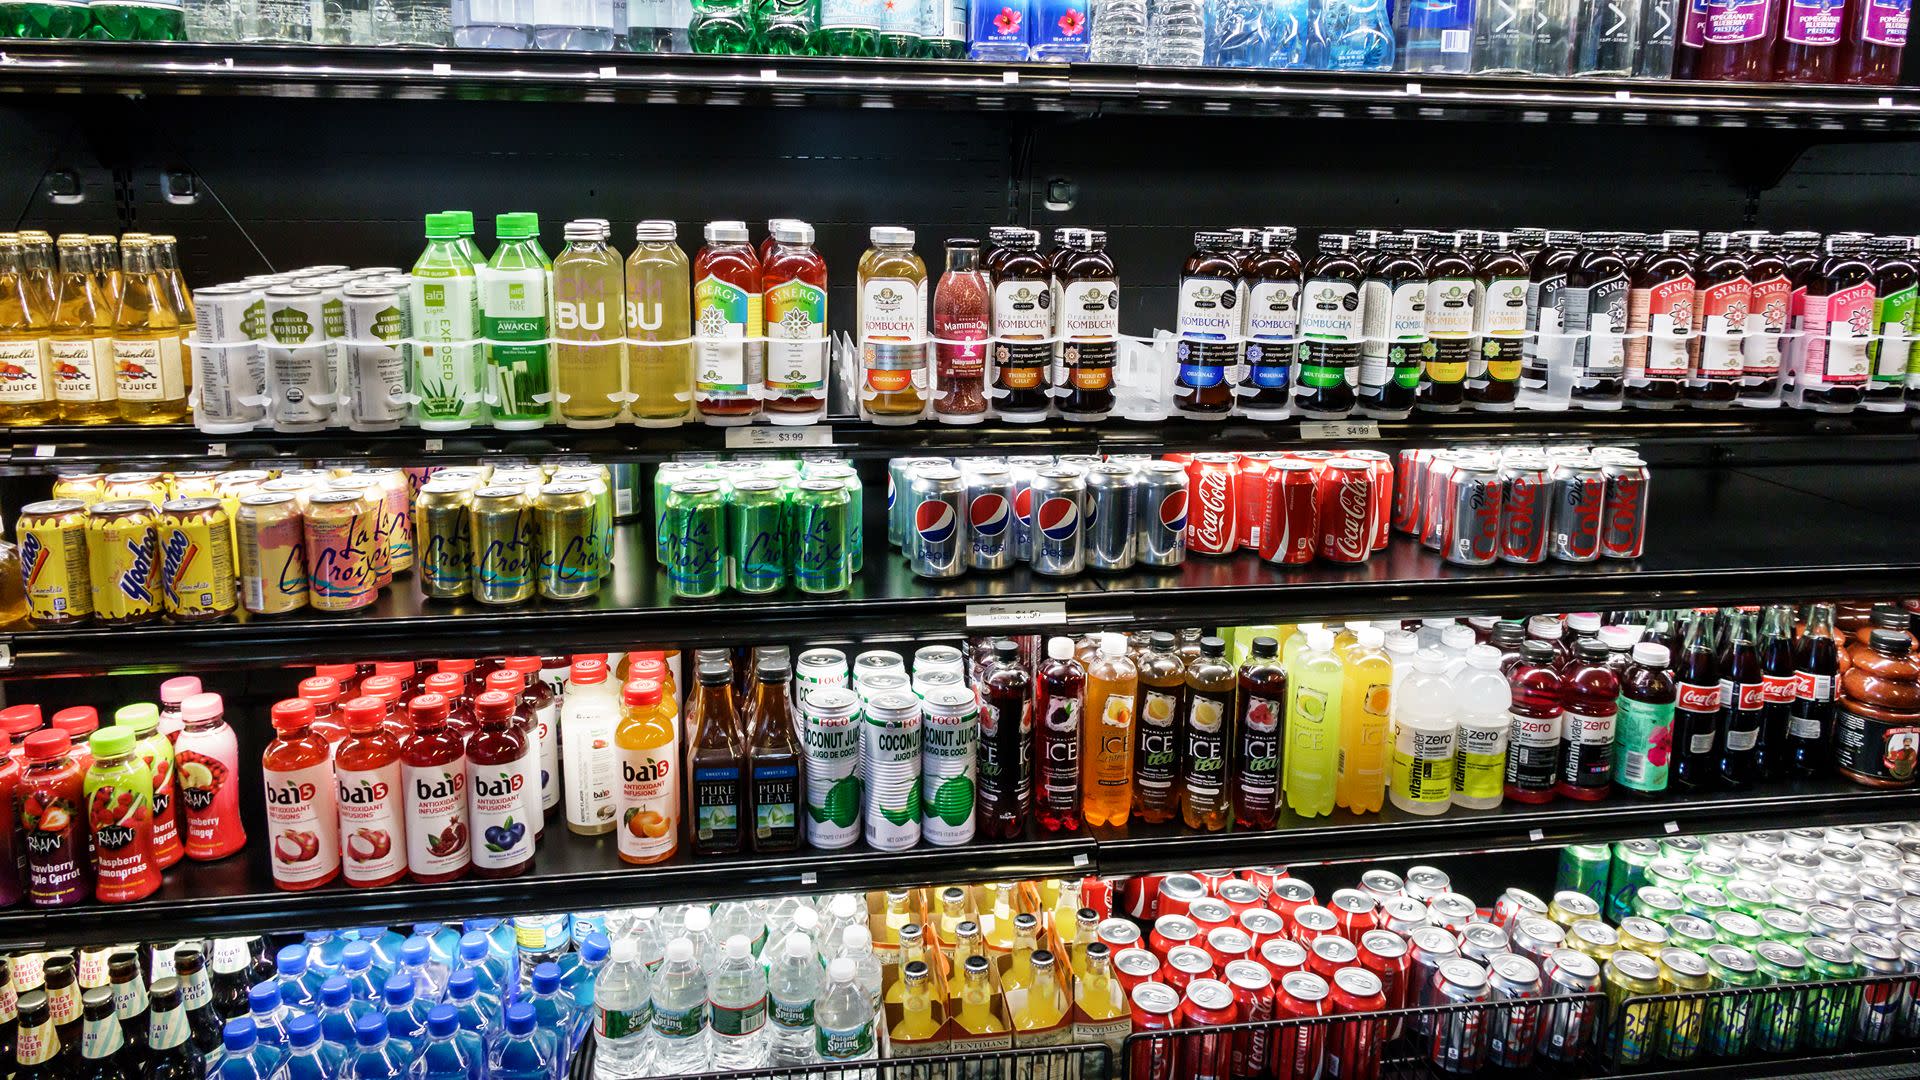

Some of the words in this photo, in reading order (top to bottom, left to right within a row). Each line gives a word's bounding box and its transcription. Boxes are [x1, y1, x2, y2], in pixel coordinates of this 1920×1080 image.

[771, 287, 821, 305] SYNERGY
[497, 322, 537, 331] AWAKEN
[865, 321, 915, 332] KOMBUCHA
[998, 319, 1047, 329] KOMBUCHA
[1067, 319, 1115, 330] KOMBUCHA
[1181, 316, 1231, 328] KOMBUCHA
[1251, 319, 1295, 329] KOMBUCH
[1302, 318, 1352, 329] KOMBUCHA
[273, 325, 308, 334] WONDER
[7, 383, 37, 391] JUICE
[65, 383, 91, 391] JUICE
[1347, 427, 1369, 435] $4.99
[1470, 479, 1485, 510] Diet
[1568, 475, 1583, 506] Diet
[1196, 469, 1228, 550] Coca-Cola
[1602, 474, 1638, 553] Coke
[1336, 474, 1368, 559] Coca-Cola
[1473, 480, 1501, 560] Coke
[1502, 477, 1535, 559] Coke
[1570, 478, 1601, 555] Coke
[680, 506, 710, 548] La
[804, 503, 831, 543] La
[340, 514, 368, 558] La
[313, 546, 379, 592] Croix
[818, 675, 843, 685] FOCO
[820, 717, 848, 727] FOCO
[932, 715, 960, 726] FOCO
[1583, 720, 1610, 731] zero
[1522, 721, 1551, 733] zero
[879, 730, 922, 751] COCONUT
[1190, 732, 1220, 741] SPARKLING
[1294, 729, 1324, 751] ICE
[1425, 734, 1452, 745] zero
[1468, 729, 1498, 741] zero
[1141, 733, 1174, 754] ICE
[1188, 738, 1221, 760] ICE
[1244, 738, 1277, 760] ICE
[1566, 717, 1583, 782] vitaminwater
[812, 750, 828, 758] JUGO
[840, 749, 855, 758] COCO
[893, 753, 907, 761] JUGO
[908, 752, 917, 760] DE
[940, 748, 949, 757] DE
[950, 747, 968, 757] COCO
[1045, 740, 1078, 762] ICE
[1147, 752, 1175, 766] tea
[1194, 758, 1224, 772] tea
[1249, 758, 1279, 772] tea
[623, 781, 665, 790] ANTIOXIDANT
[700, 783, 735, 796] PURE
[759, 782, 793, 795] PURE
[623, 789, 657, 797] INFUSIONS
[760, 792, 790, 803] LEAF
[183, 791, 214, 809] RAAW
[418, 794, 461, 809] ANTIOXIDANT
[477, 794, 519, 807] ANTIOXIDANT
[701, 794, 733, 805] LEAF
[269, 804, 311, 813] ANTIOXIDANT
[341, 803, 384, 813] ANTIOXIDANT
[418, 804, 455, 815] INFUSIONS
[477, 801, 511, 812] INFUSIONS
[97, 827, 134, 846] RAAW
[28, 833, 62, 854] RAAW
[49, 867, 80, 884] Carrot
[184, 989, 206, 1001] COLA
[778, 1003, 802, 1014] Poland
[656, 1010, 680, 1021] Poland
[775, 1009, 804, 1023] Spring
[654, 1016, 682, 1030] Spring
[1076, 1022, 1131, 1035] FENTIMANS
[830, 1033, 856, 1043] Poland
[827, 1039, 859, 1053] Spring
[953, 1039, 1009, 1051] FENTIMANS
